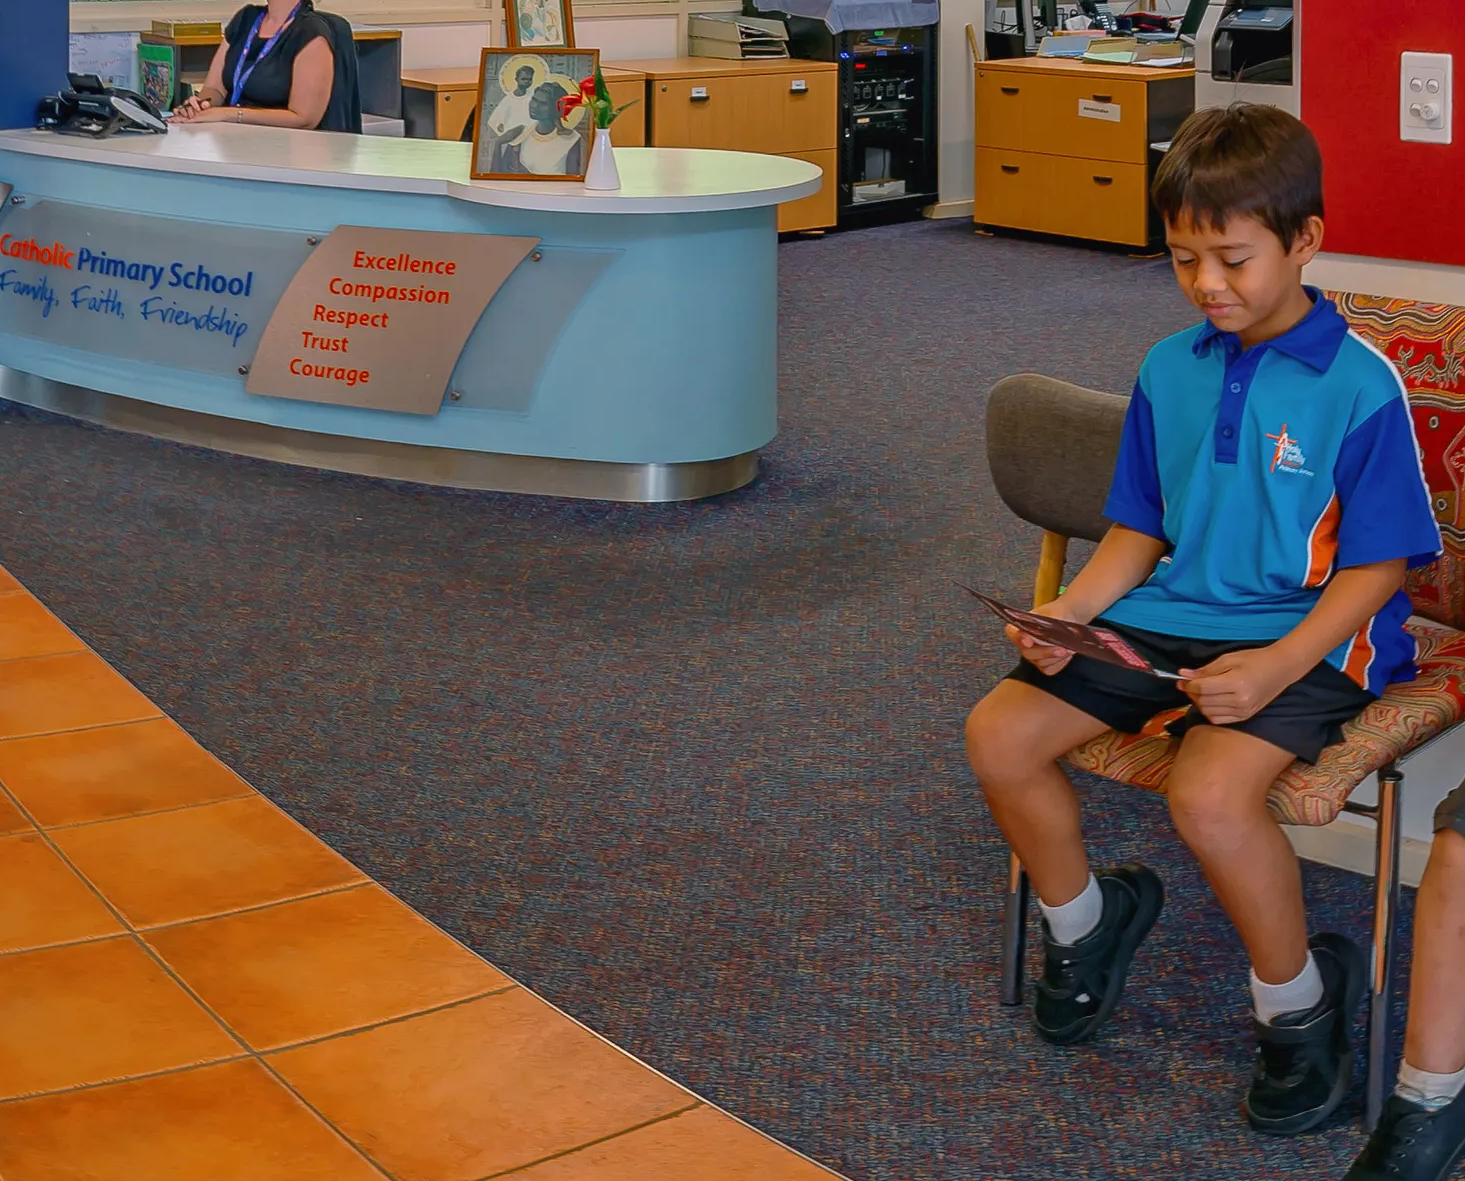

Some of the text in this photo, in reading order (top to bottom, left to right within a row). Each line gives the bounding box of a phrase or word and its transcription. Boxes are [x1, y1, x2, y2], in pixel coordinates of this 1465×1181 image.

[0, 233, 253, 297] Catholic Primary School
[353, 250, 457, 275] Excellence
[329, 277, 451, 305] Compassion
[71, 285, 125, 319] Faith,
[139, 296, 249, 348] Friendship
[313, 304, 389, 329] Respect
[301, 331, 349, 353] Trust
[289, 358, 370, 387] Courage
